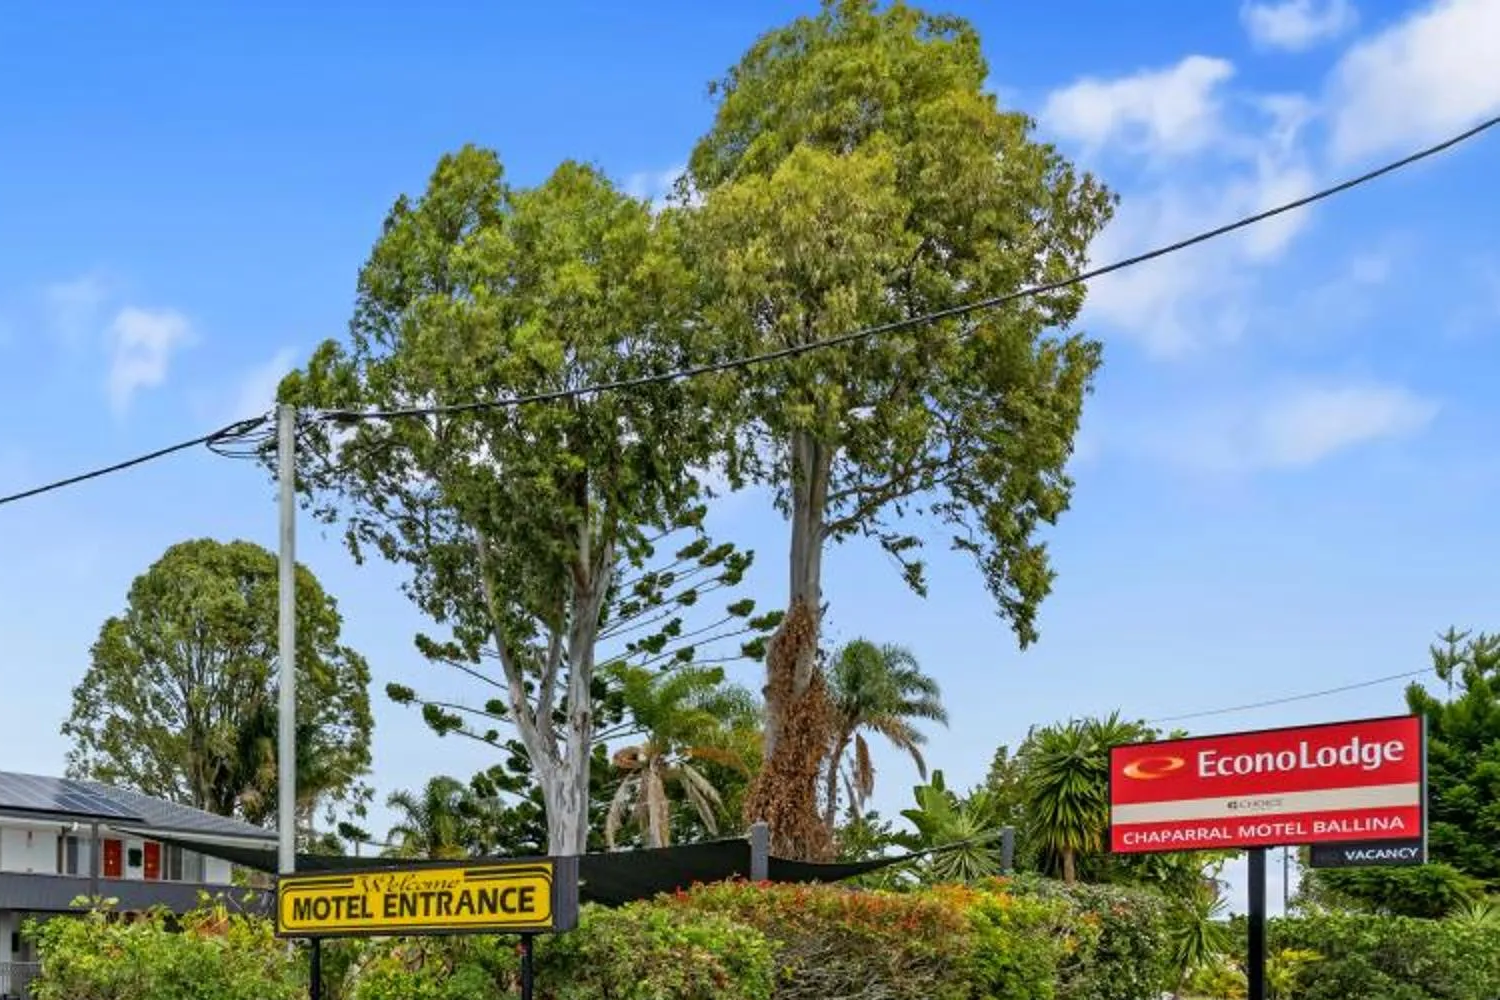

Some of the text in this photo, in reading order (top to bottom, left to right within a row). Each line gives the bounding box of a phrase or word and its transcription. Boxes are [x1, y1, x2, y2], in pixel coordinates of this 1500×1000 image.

[1123, 815, 1405, 845] CHAPARRAL MOTEL BALLINA
[1344, 847, 1419, 861] VACANCY
[292, 886, 536, 921] MOTEL ENTRANCE
